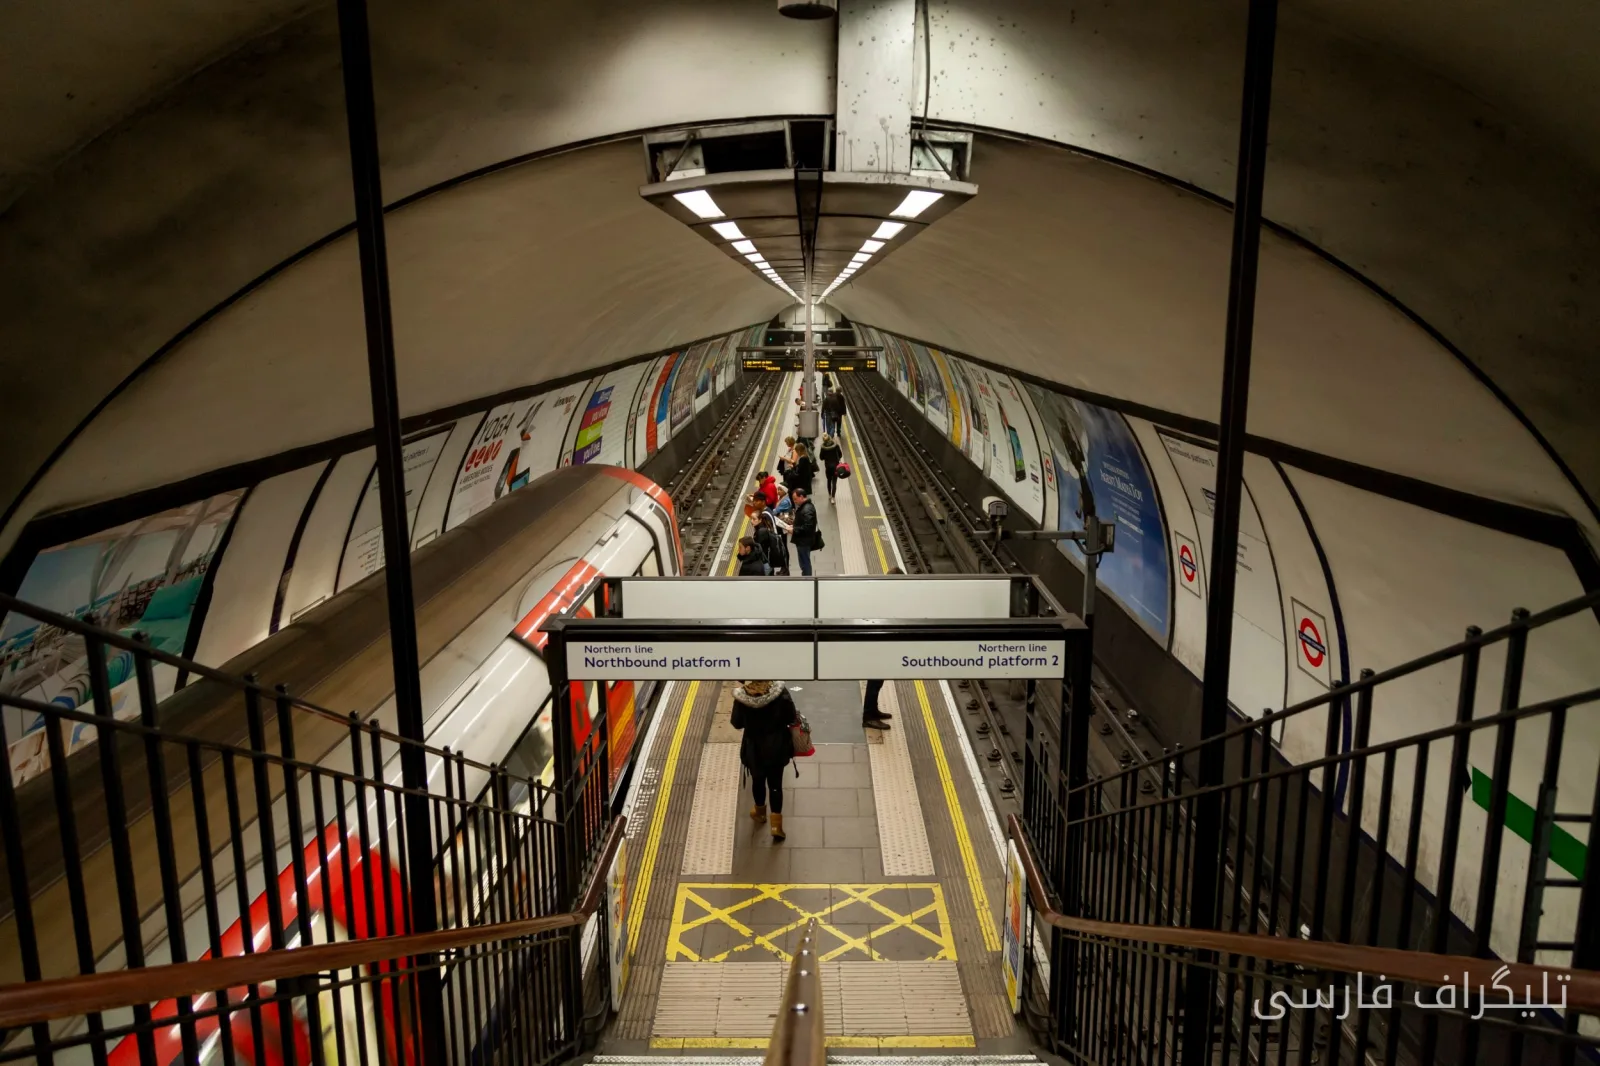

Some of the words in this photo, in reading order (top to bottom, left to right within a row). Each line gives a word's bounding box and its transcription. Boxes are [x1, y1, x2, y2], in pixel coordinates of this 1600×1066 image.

[478, 412, 515, 445] YOGA
[584, 645, 631, 654] Northern
[634, 645, 653, 654] line
[978, 643, 1025, 653] Northern
[1028, 643, 1047, 653] line
[584, 656, 666, 668] Northbound
[671, 656, 731, 671] platform
[735, 656, 741, 668] 1
[901, 655, 984, 667] Southbound
[988, 654, 1048, 669] platform
[1051, 655, 1059, 667] 2
